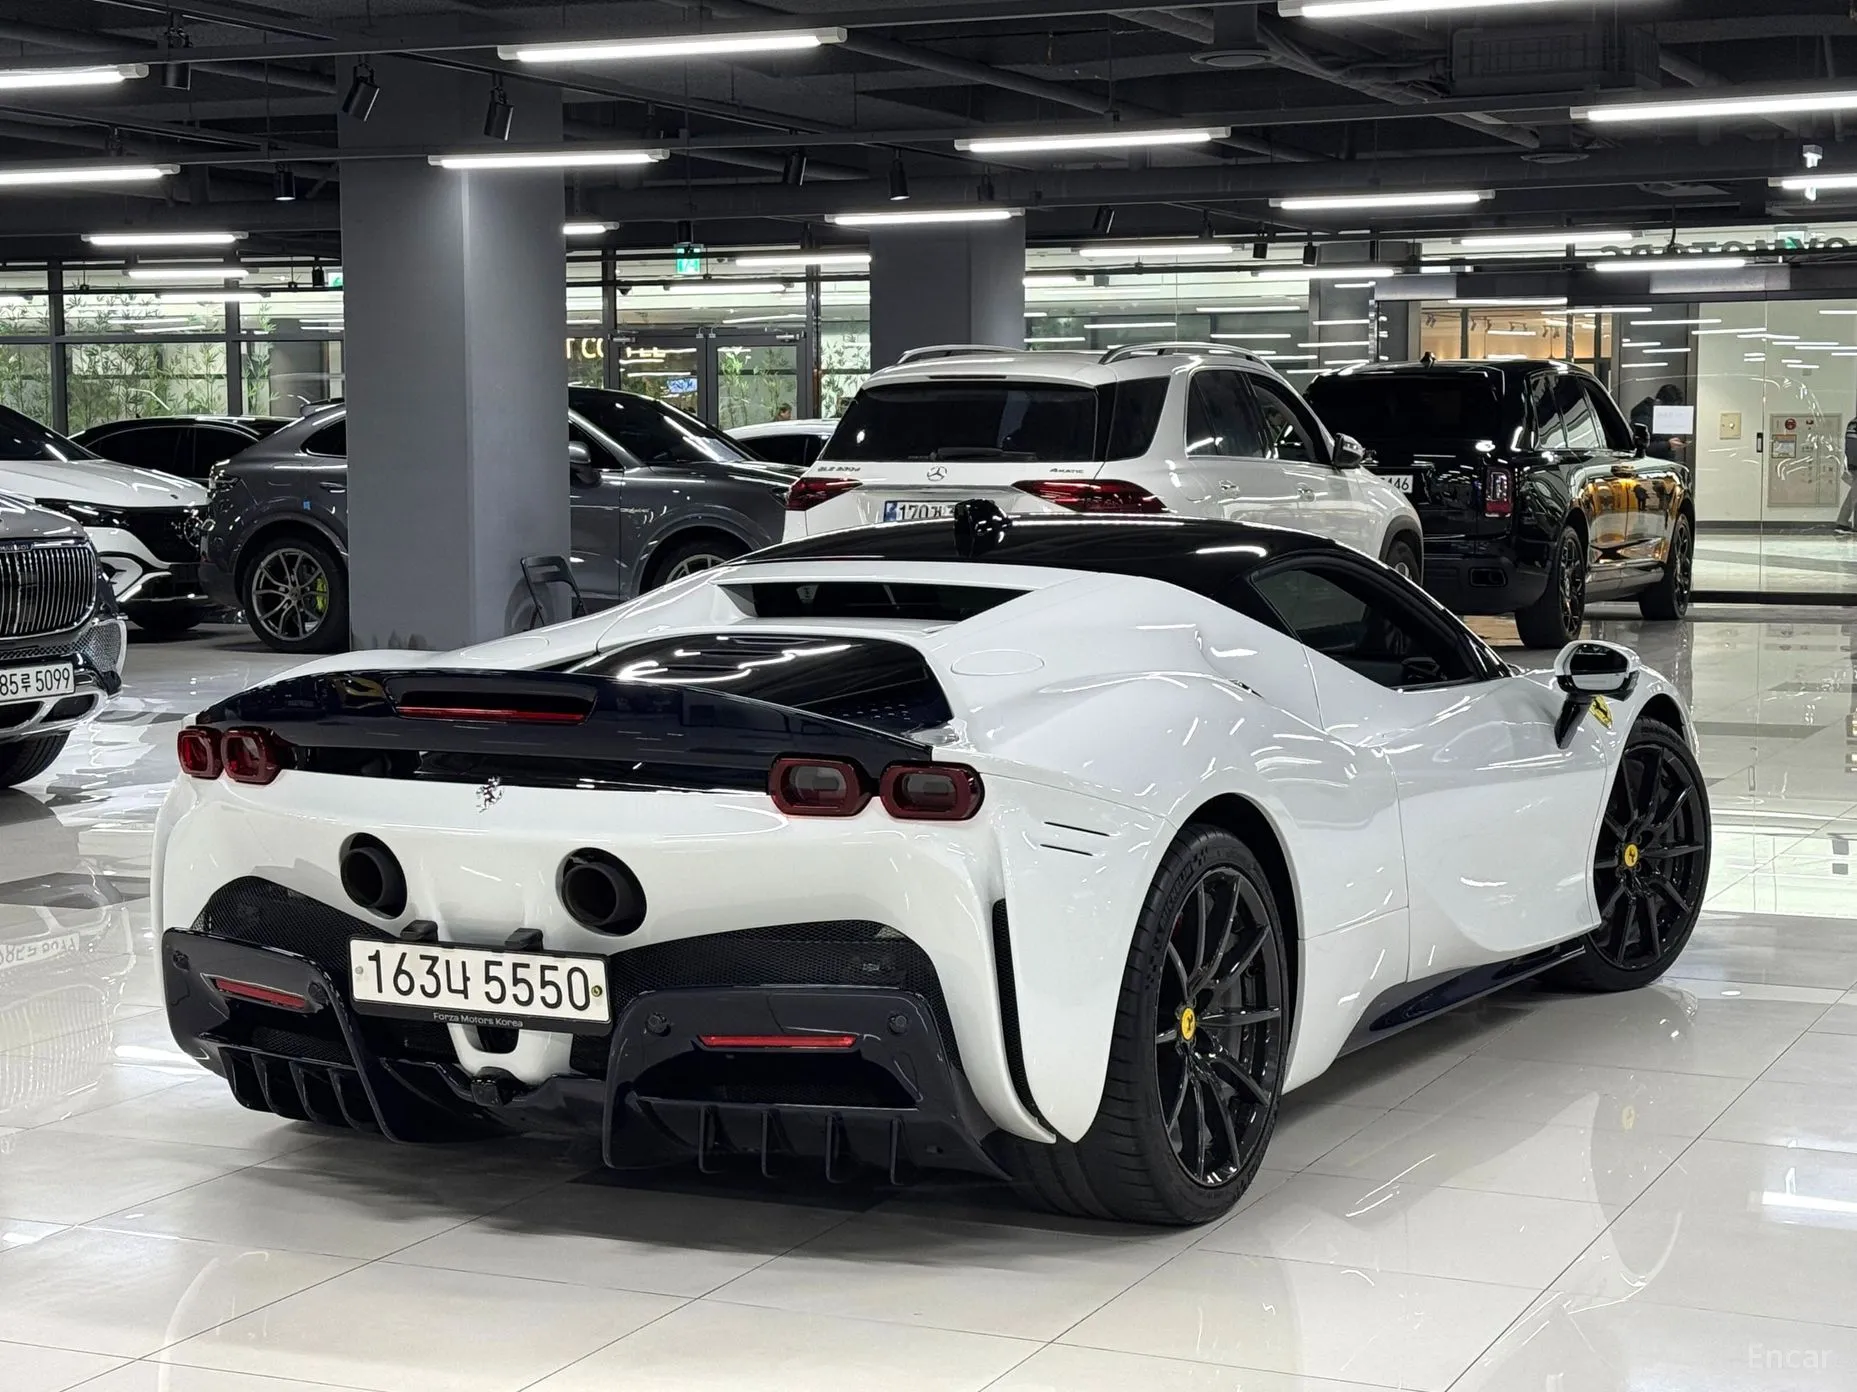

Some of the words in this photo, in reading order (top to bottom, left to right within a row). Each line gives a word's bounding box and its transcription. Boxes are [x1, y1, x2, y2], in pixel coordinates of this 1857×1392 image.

[36, 667, 70, 692] 5099
[368, 949, 471, 1000] 163나
[484, 960, 591, 1011] 5550
[433, 1012, 459, 1021] Forza
[460, 1015, 494, 1025] Motors
[495, 1017, 524, 1028] Korea
